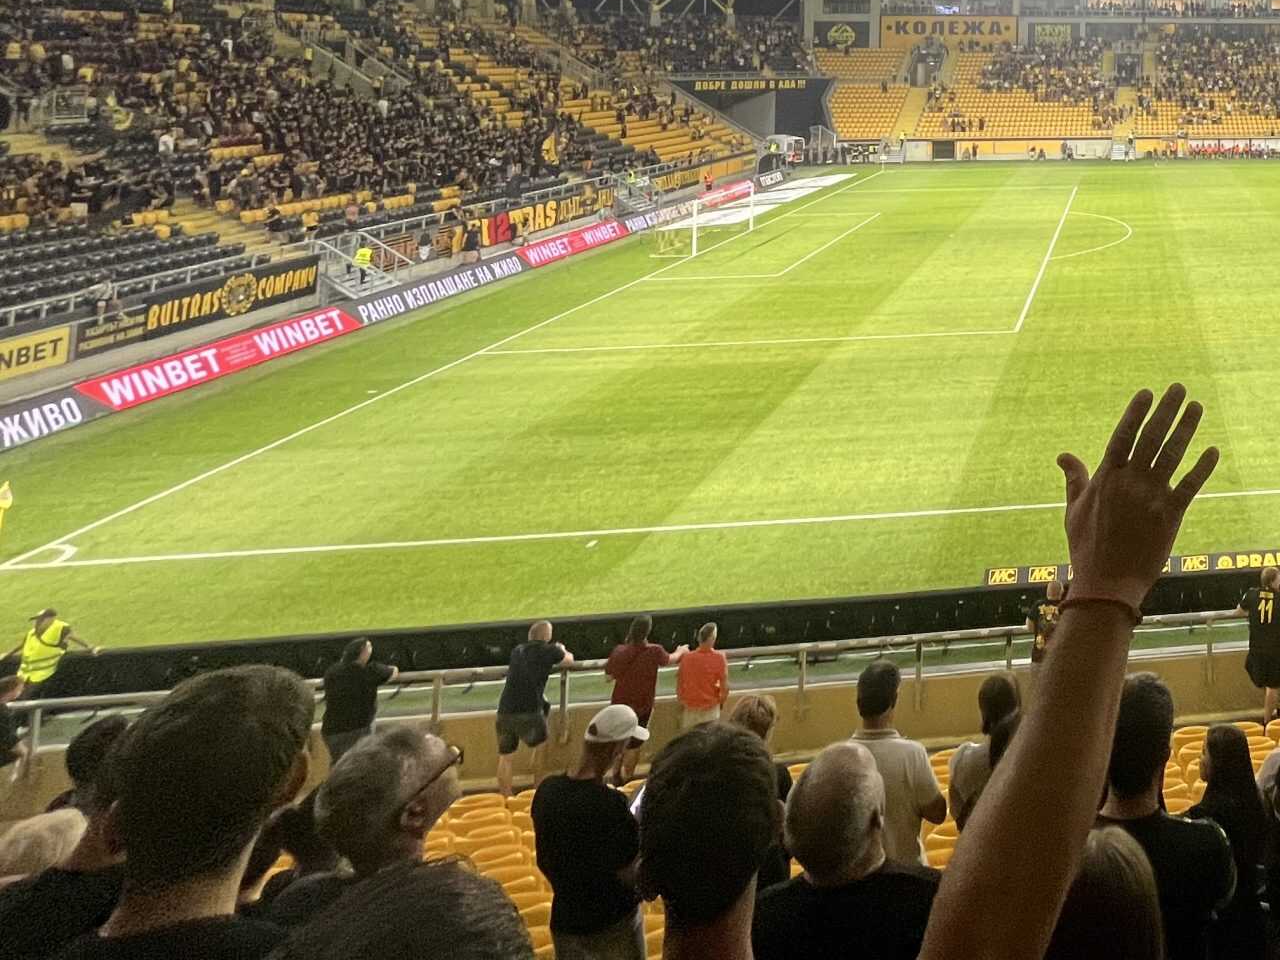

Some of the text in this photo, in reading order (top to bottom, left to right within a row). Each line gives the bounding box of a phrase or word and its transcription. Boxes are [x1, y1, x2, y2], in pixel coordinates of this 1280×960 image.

[894, 20, 1001, 37] КОЛЕЖА
[525, 222, 622, 265] WINBET WINBET
[258, 265, 317, 300] COMPANY
[358, 294, 405, 324] РАННО
[475, 265, 494, 285] НА
[490, 256, 523, 278] ЖИВО
[100, 348, 221, 406] WINBET
[252, 309, 345, 356] WINBET
[0, 397, 83, 447] ЖИВО
[1258, 599, 1273, 624] 11
